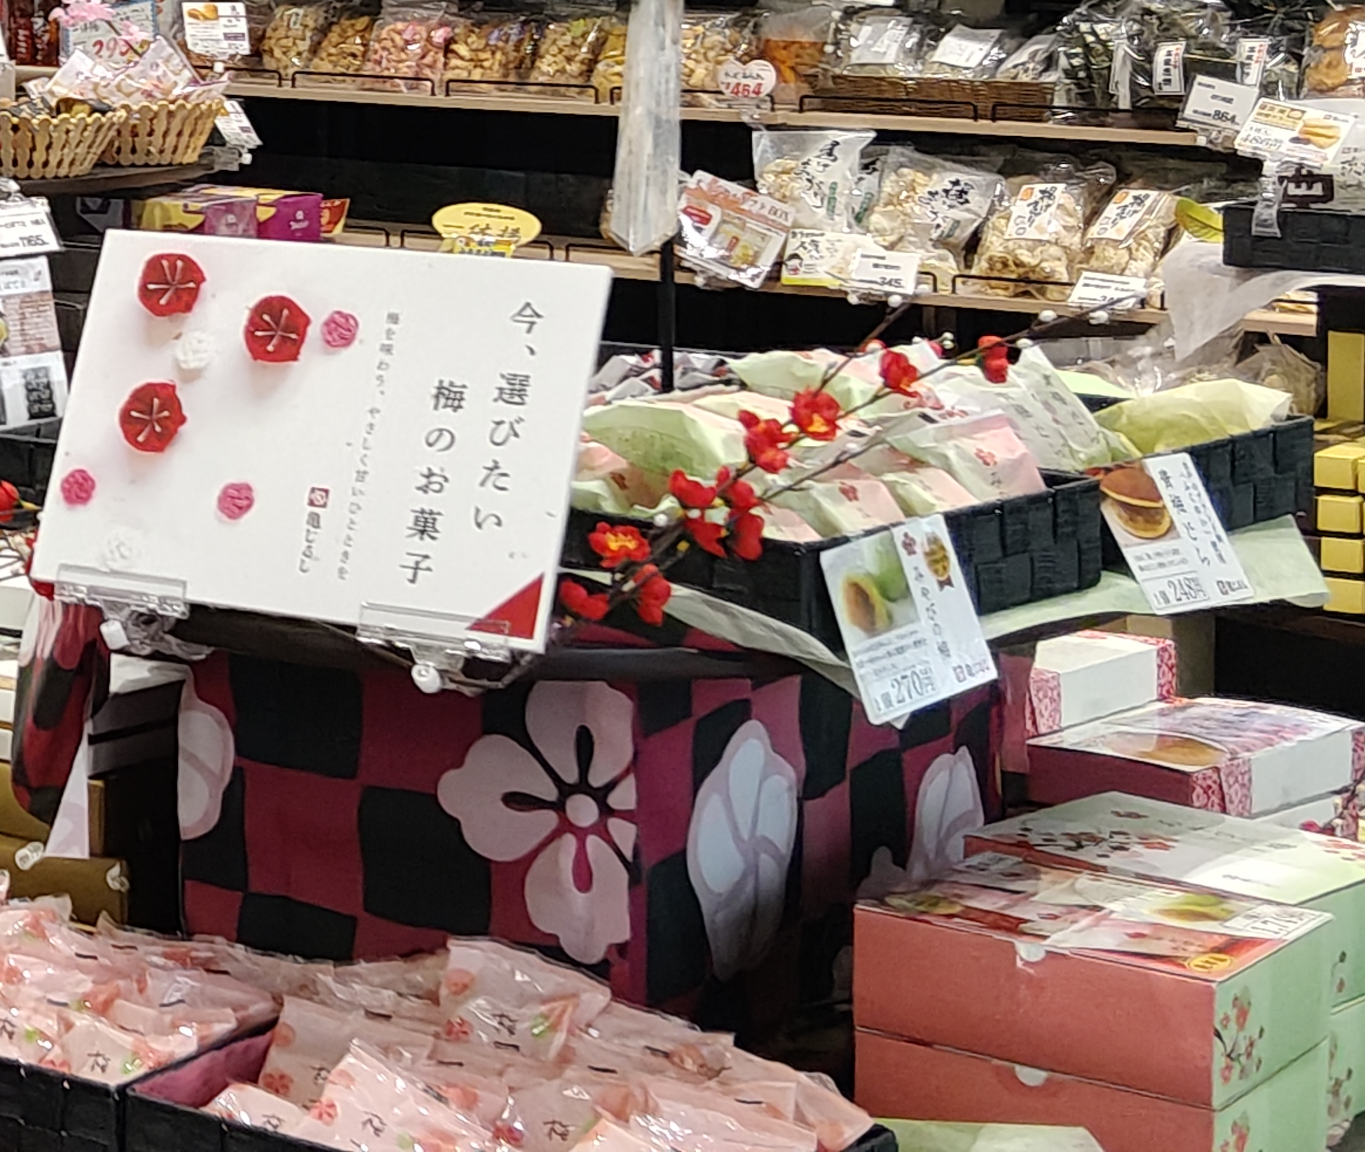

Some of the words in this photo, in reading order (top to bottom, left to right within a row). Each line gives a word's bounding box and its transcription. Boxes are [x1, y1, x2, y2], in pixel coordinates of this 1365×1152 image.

[398, 378, 470, 586] 梅のお菓子
[471, 299, 546, 532] 今、選びたい
